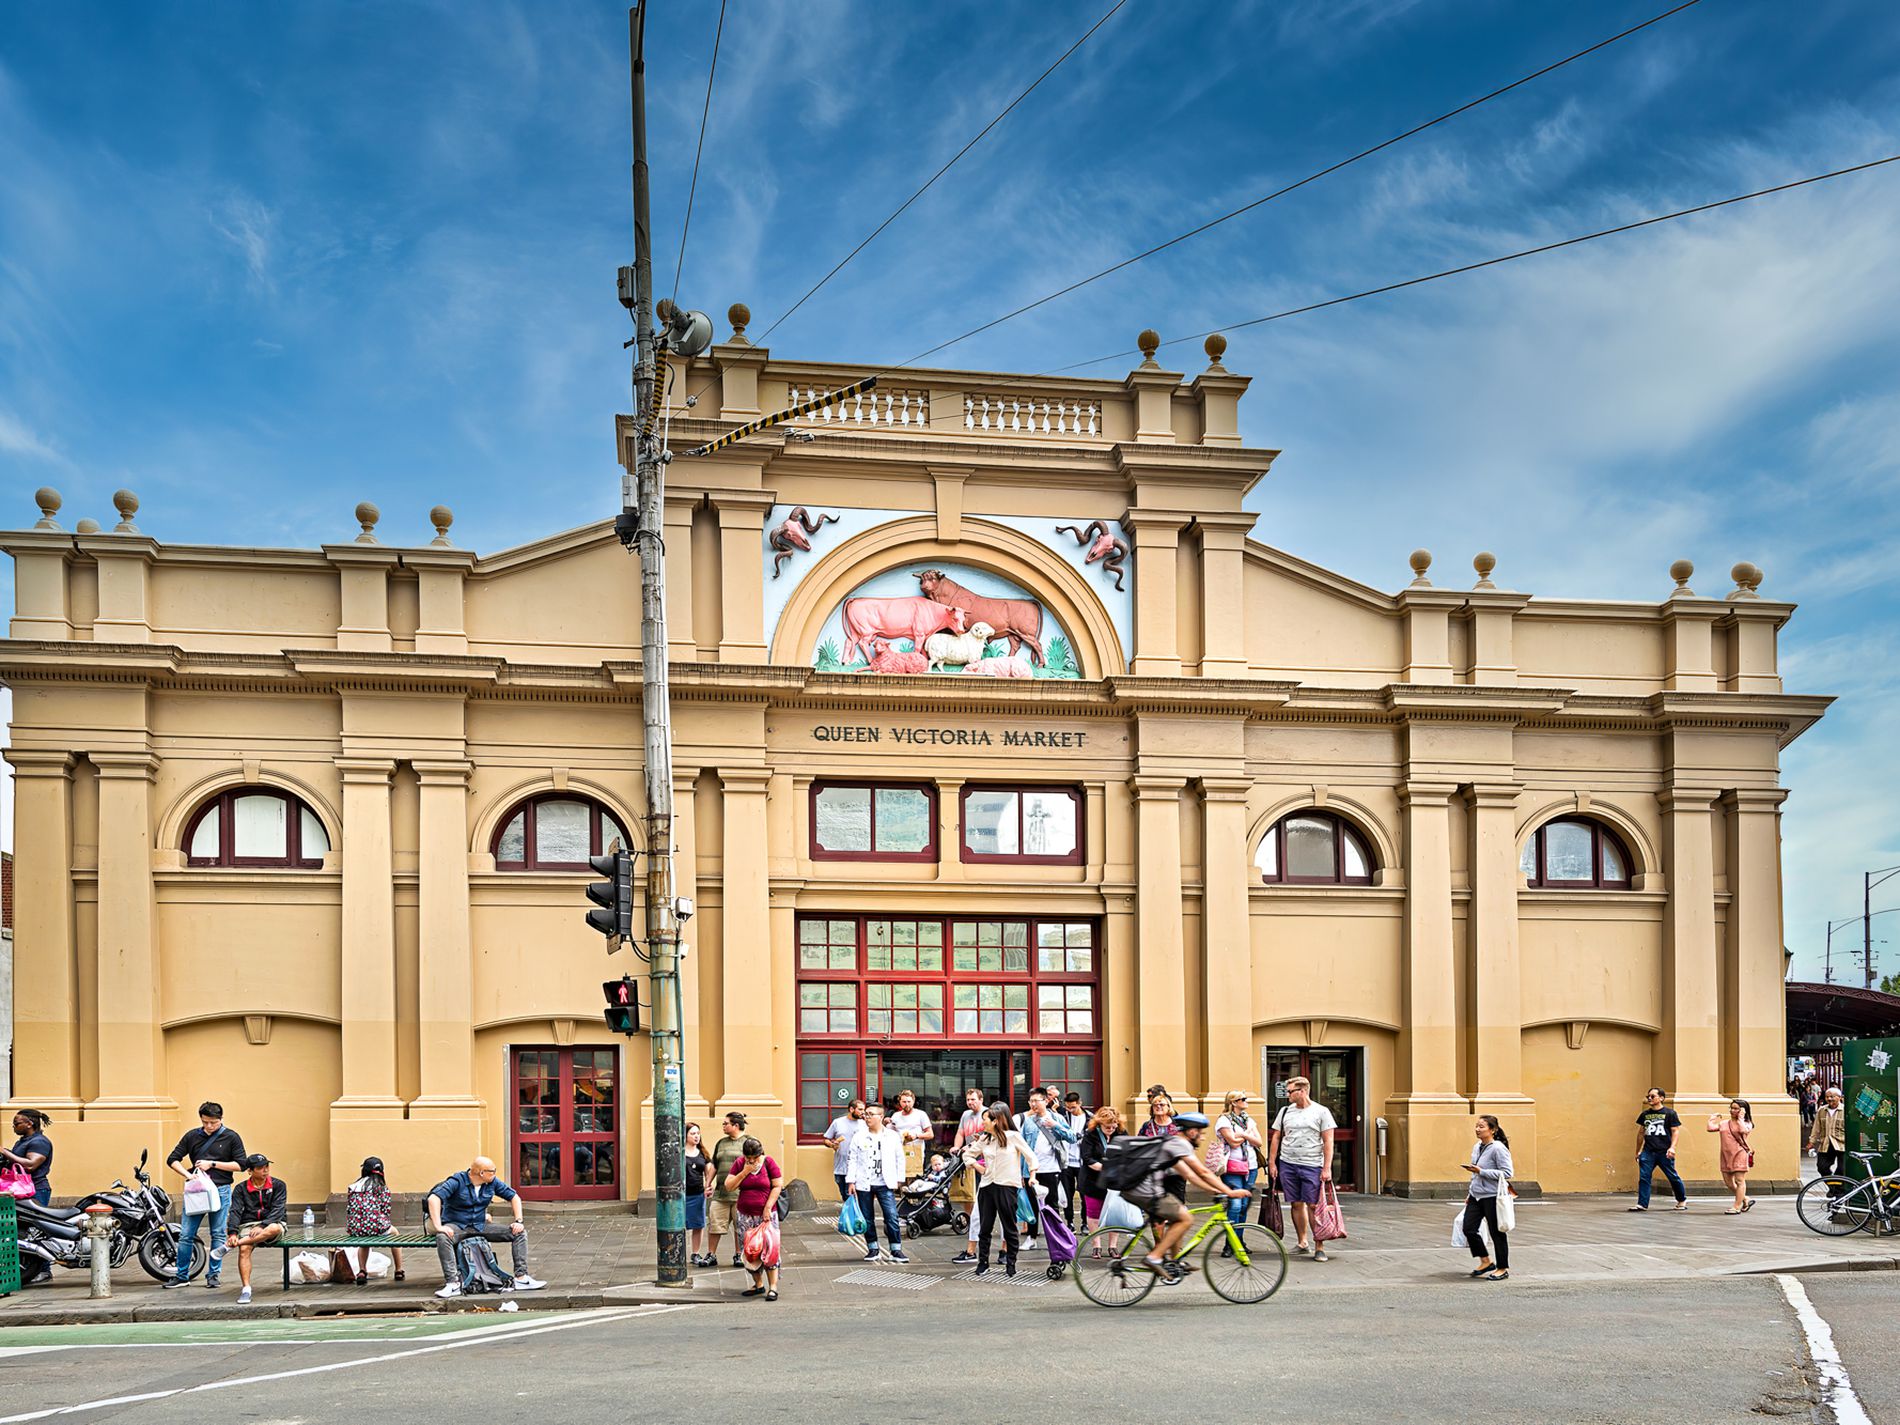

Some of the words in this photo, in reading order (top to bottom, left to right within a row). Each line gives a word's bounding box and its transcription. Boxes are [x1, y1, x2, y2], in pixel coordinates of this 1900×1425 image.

[814, 725, 880, 743] QUEEN
[891, 728, 992, 746] VICTORIA
[1002, 730, 1087, 748] MARKET
